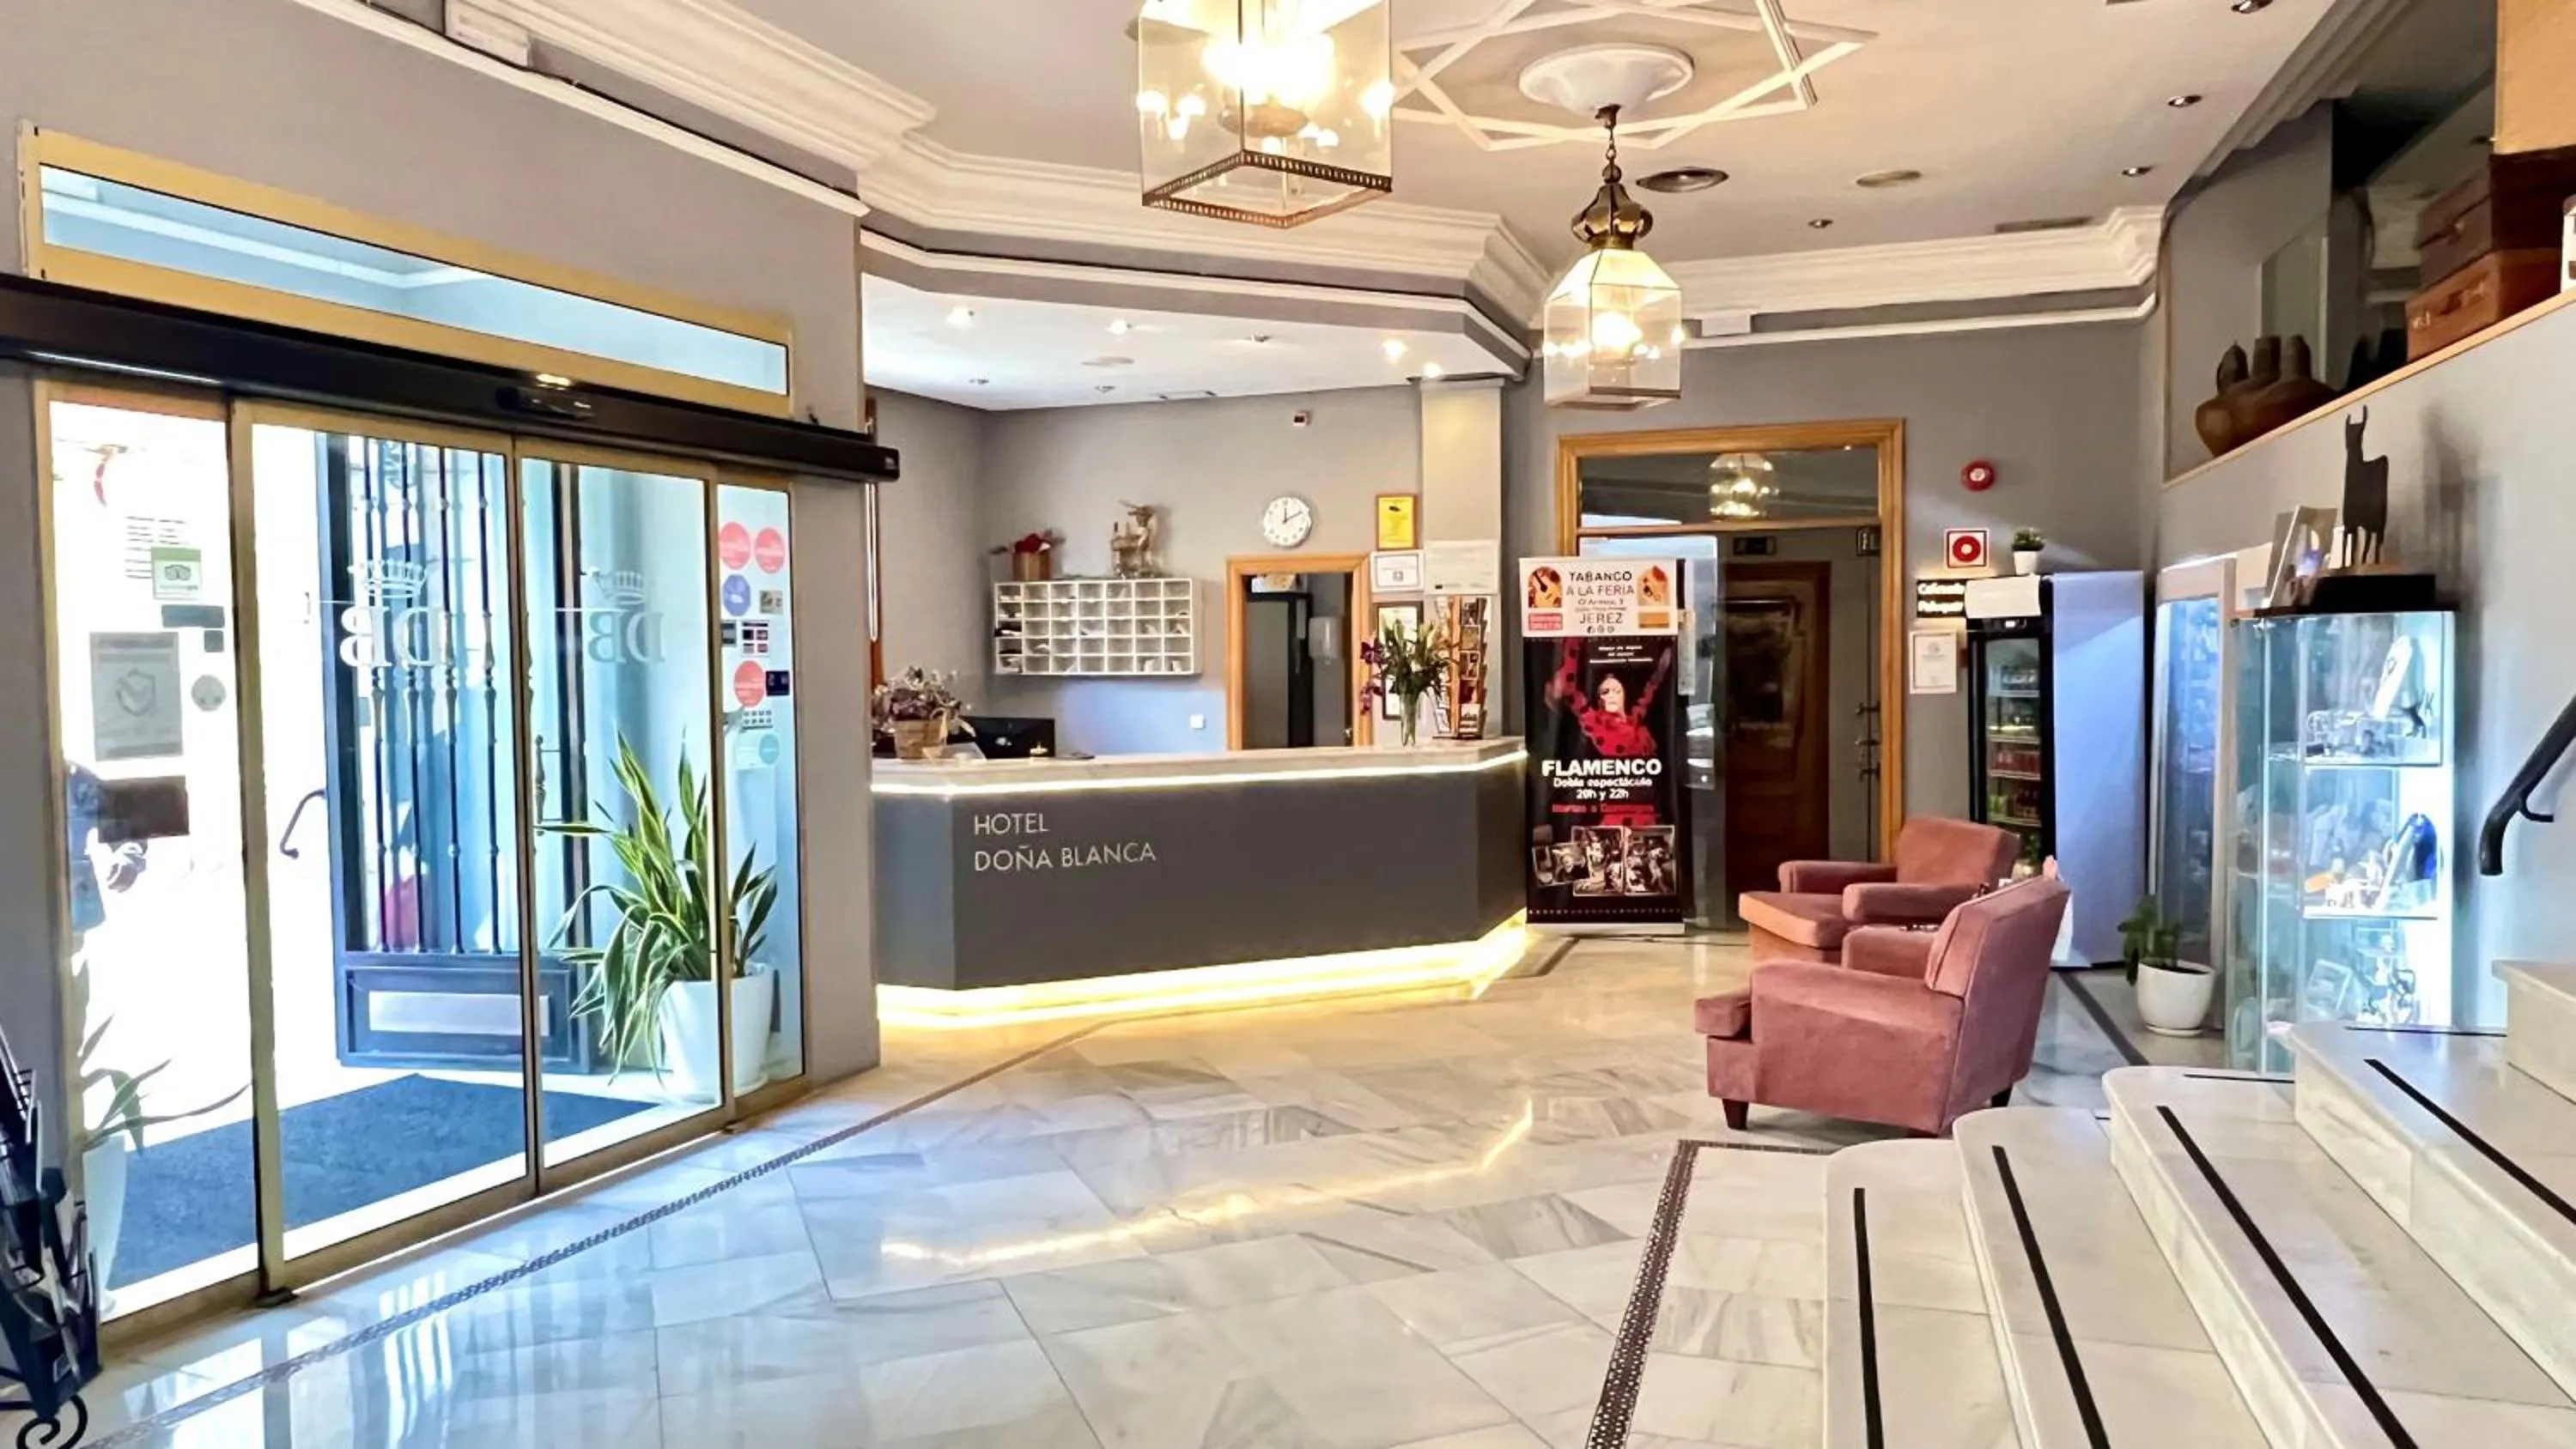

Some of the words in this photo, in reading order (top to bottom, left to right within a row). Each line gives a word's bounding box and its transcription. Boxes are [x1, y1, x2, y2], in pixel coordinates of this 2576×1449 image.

[1570, 571, 1632, 582] TABANCO
[1566, 585, 1575, 596] A
[1577, 585, 1595, 597] LA
[1597, 585, 1635, 597] FERIA
[1579, 612, 1624, 624] JEREZ
[1541, 758, 1662, 776] FLAMENCO
[1576, 788, 1597, 799] 20h
[1599, 791, 1607, 801] y
[1608, 788, 1630, 799] 22h
[974, 813, 1049, 835] HOTEL
[974, 845, 1054, 872] DOÑA
[1060, 842, 1157, 868] BLANCA
